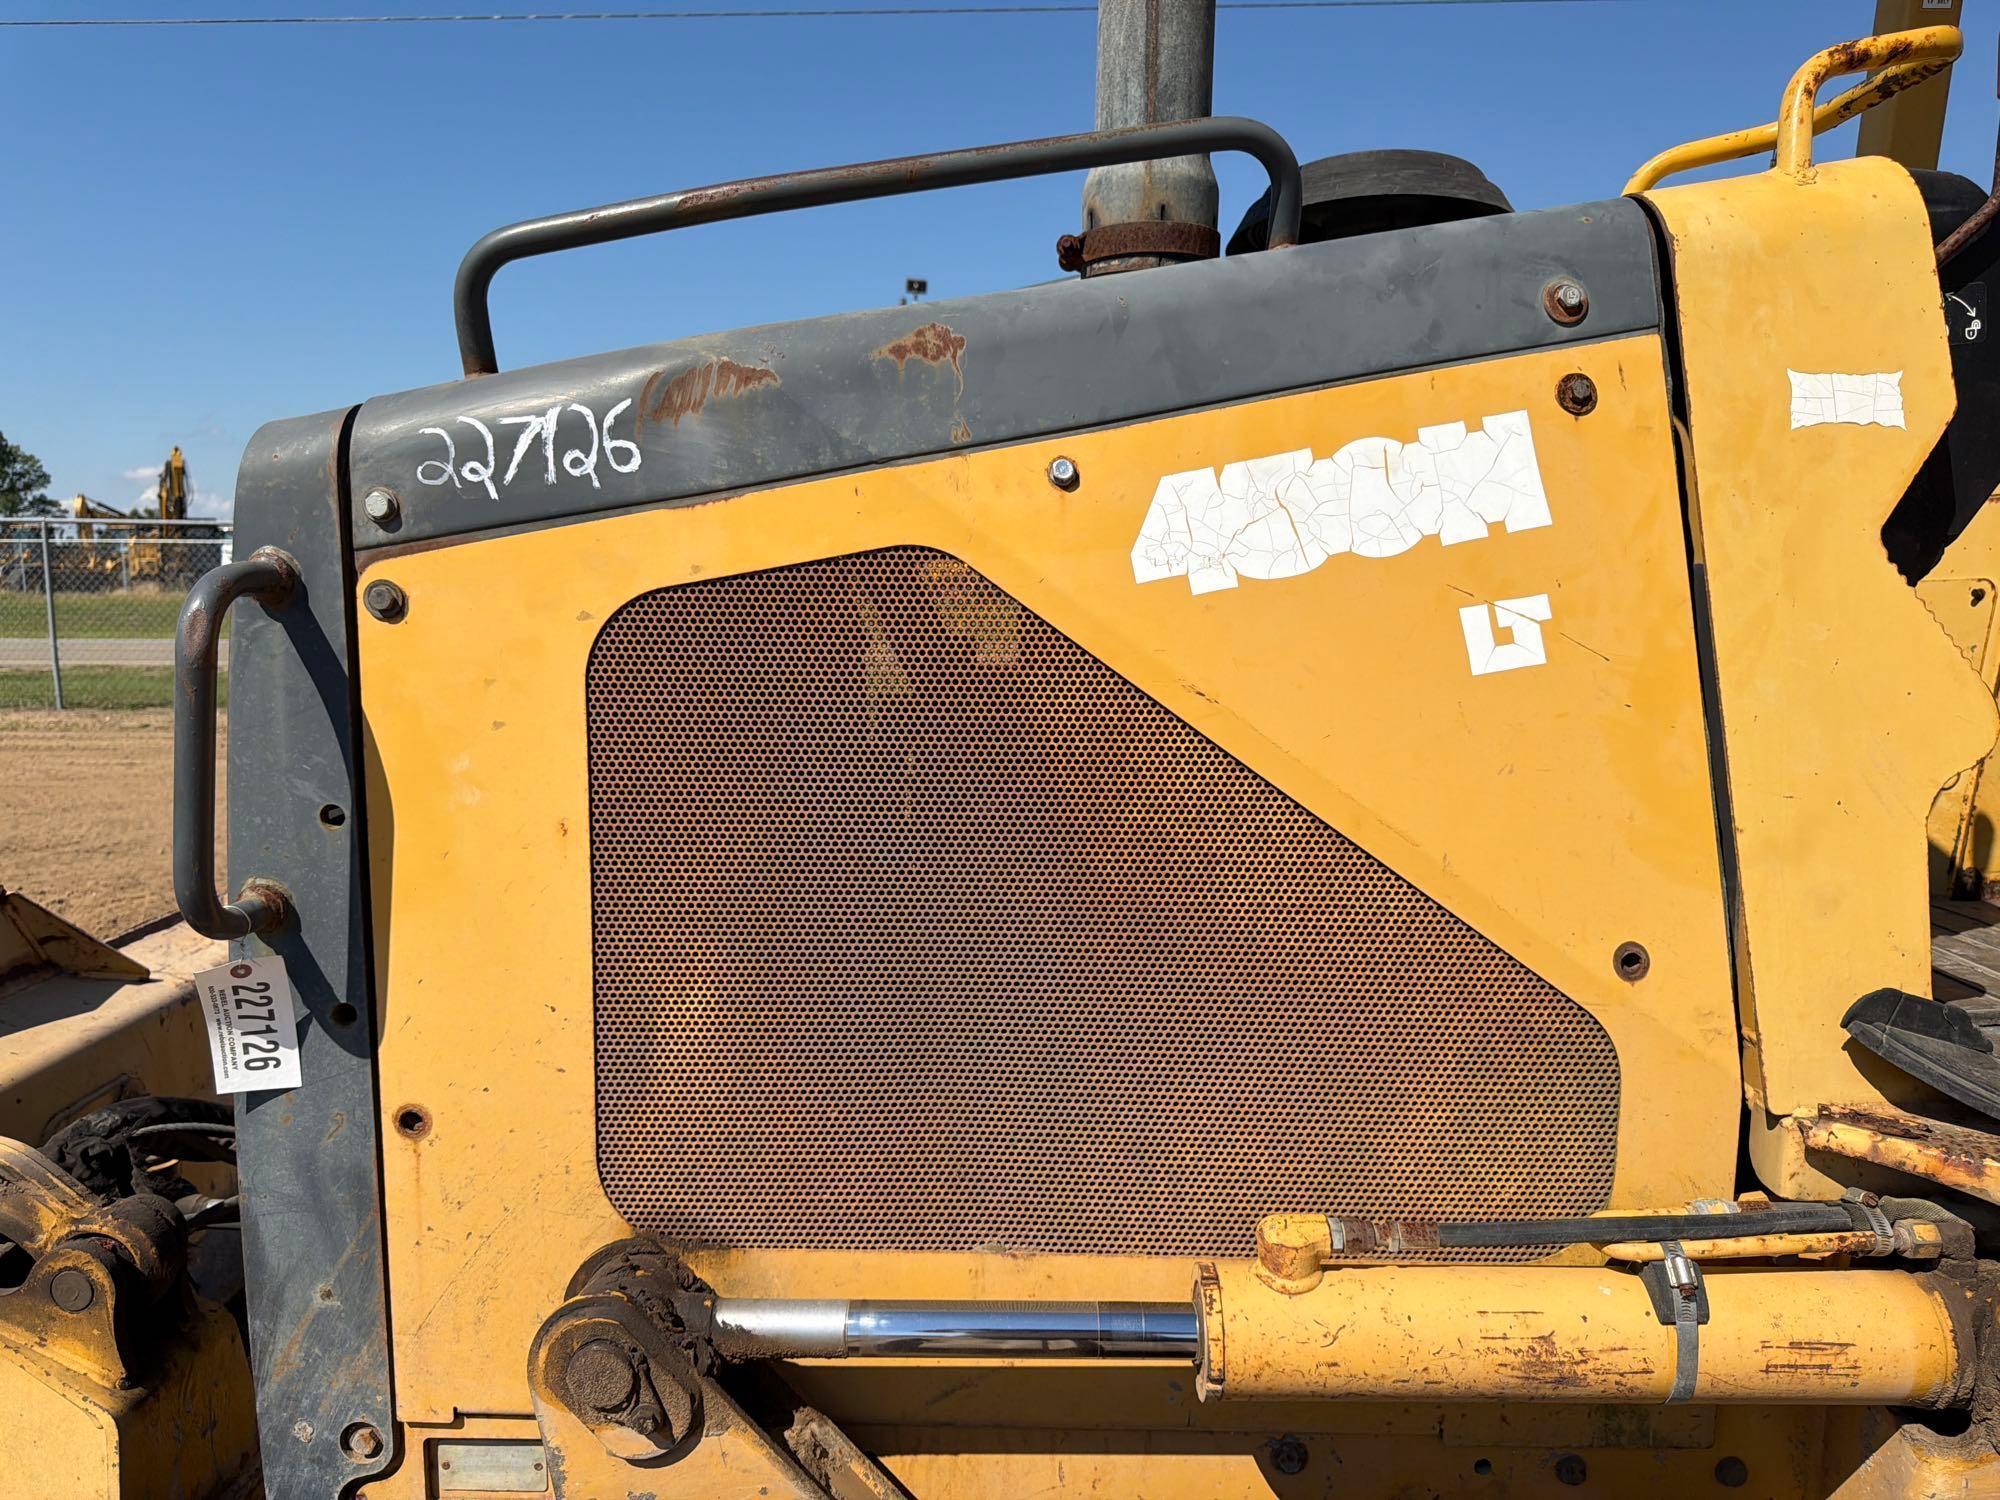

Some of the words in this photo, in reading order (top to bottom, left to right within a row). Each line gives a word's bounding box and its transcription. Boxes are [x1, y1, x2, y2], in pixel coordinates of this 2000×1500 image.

[416, 398, 641, 502] 227126
[215, 1018, 230, 1079] www.rebelauction.com
[218, 989, 227, 1007] REBEL
[223, 1008, 233, 1036] AUCTION
[228, 1036, 239, 1071] COMPANY
[231, 981, 282, 1071] 227126
